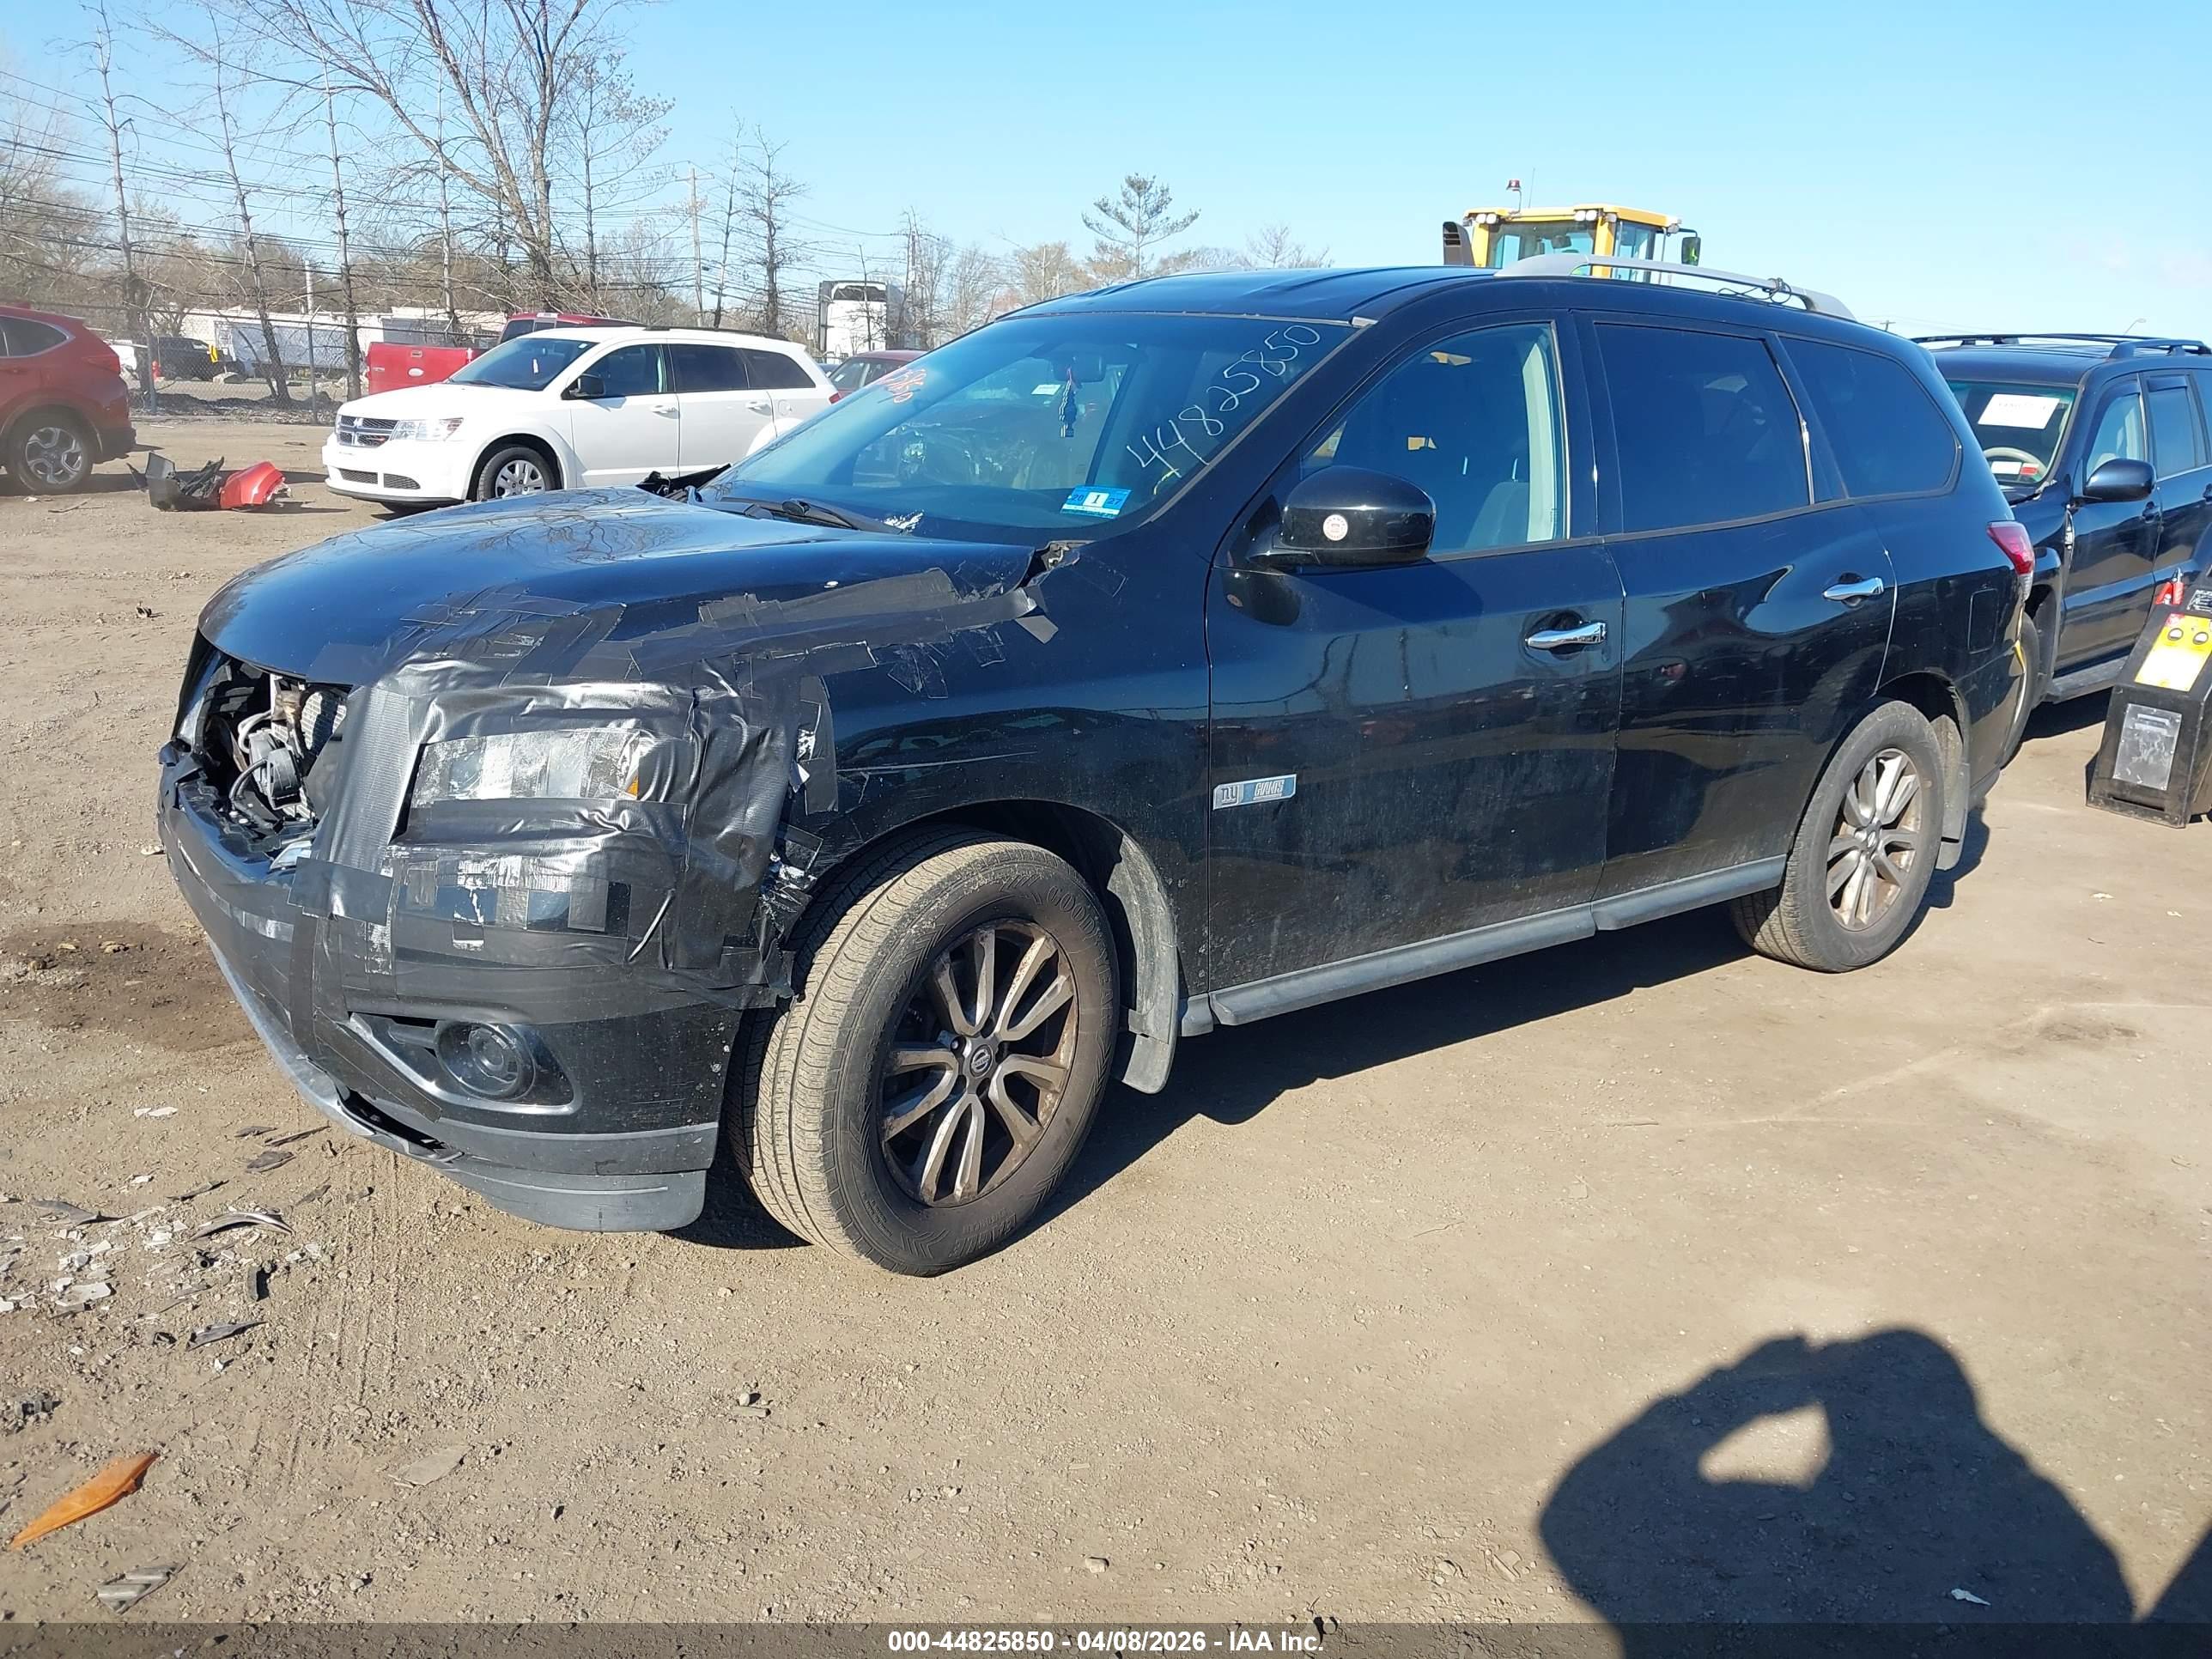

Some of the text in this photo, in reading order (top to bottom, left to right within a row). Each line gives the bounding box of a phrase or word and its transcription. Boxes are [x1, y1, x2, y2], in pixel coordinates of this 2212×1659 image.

[1126, 324, 1321, 479] 44825850
[1091, 494, 1101, 504] 1
[1254, 779, 1285, 798] GIANTS
